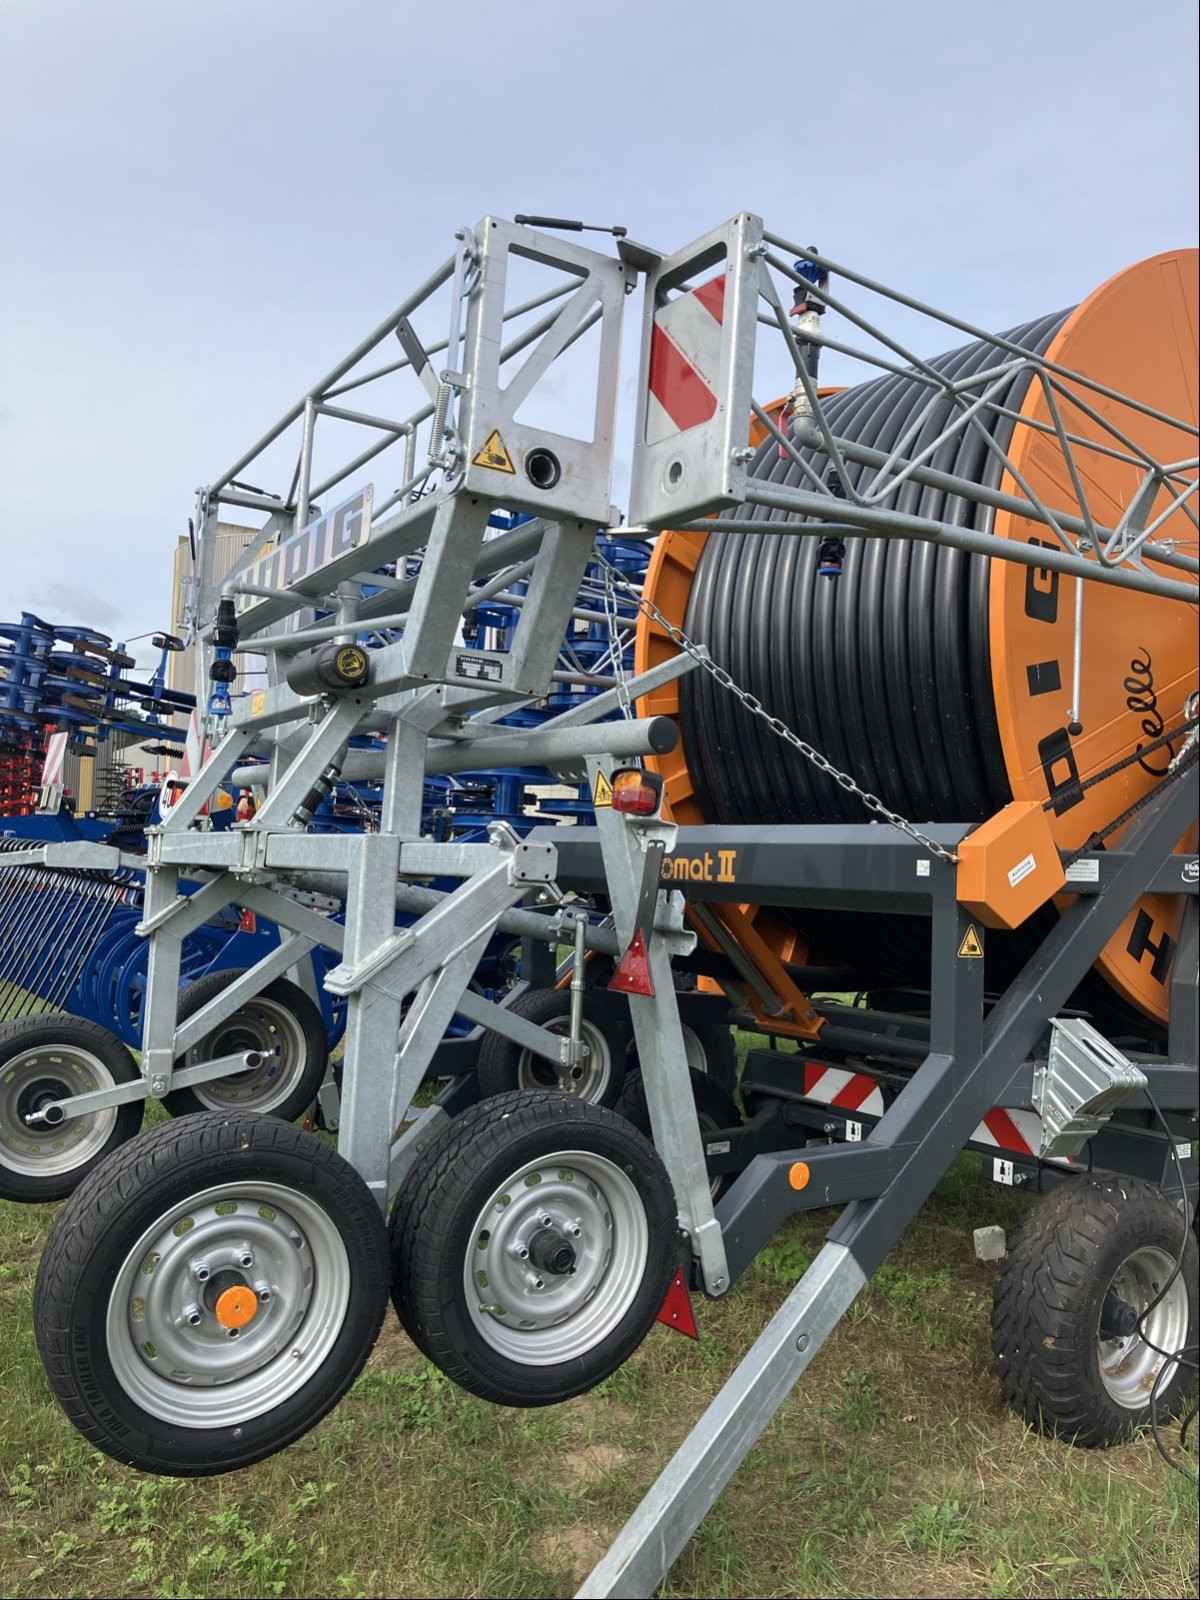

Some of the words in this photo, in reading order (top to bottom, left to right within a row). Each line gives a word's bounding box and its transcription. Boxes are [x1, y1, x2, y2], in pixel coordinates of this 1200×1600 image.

[1124, 646, 1175, 776] Celle
[661, 852, 713, 880] omat
[717, 850, 736, 882] II
[74, 1323, 88, 1352] LINE
[76, 1357, 102, 1407] TRAILER
[98, 1408, 131, 1437] BOKA
